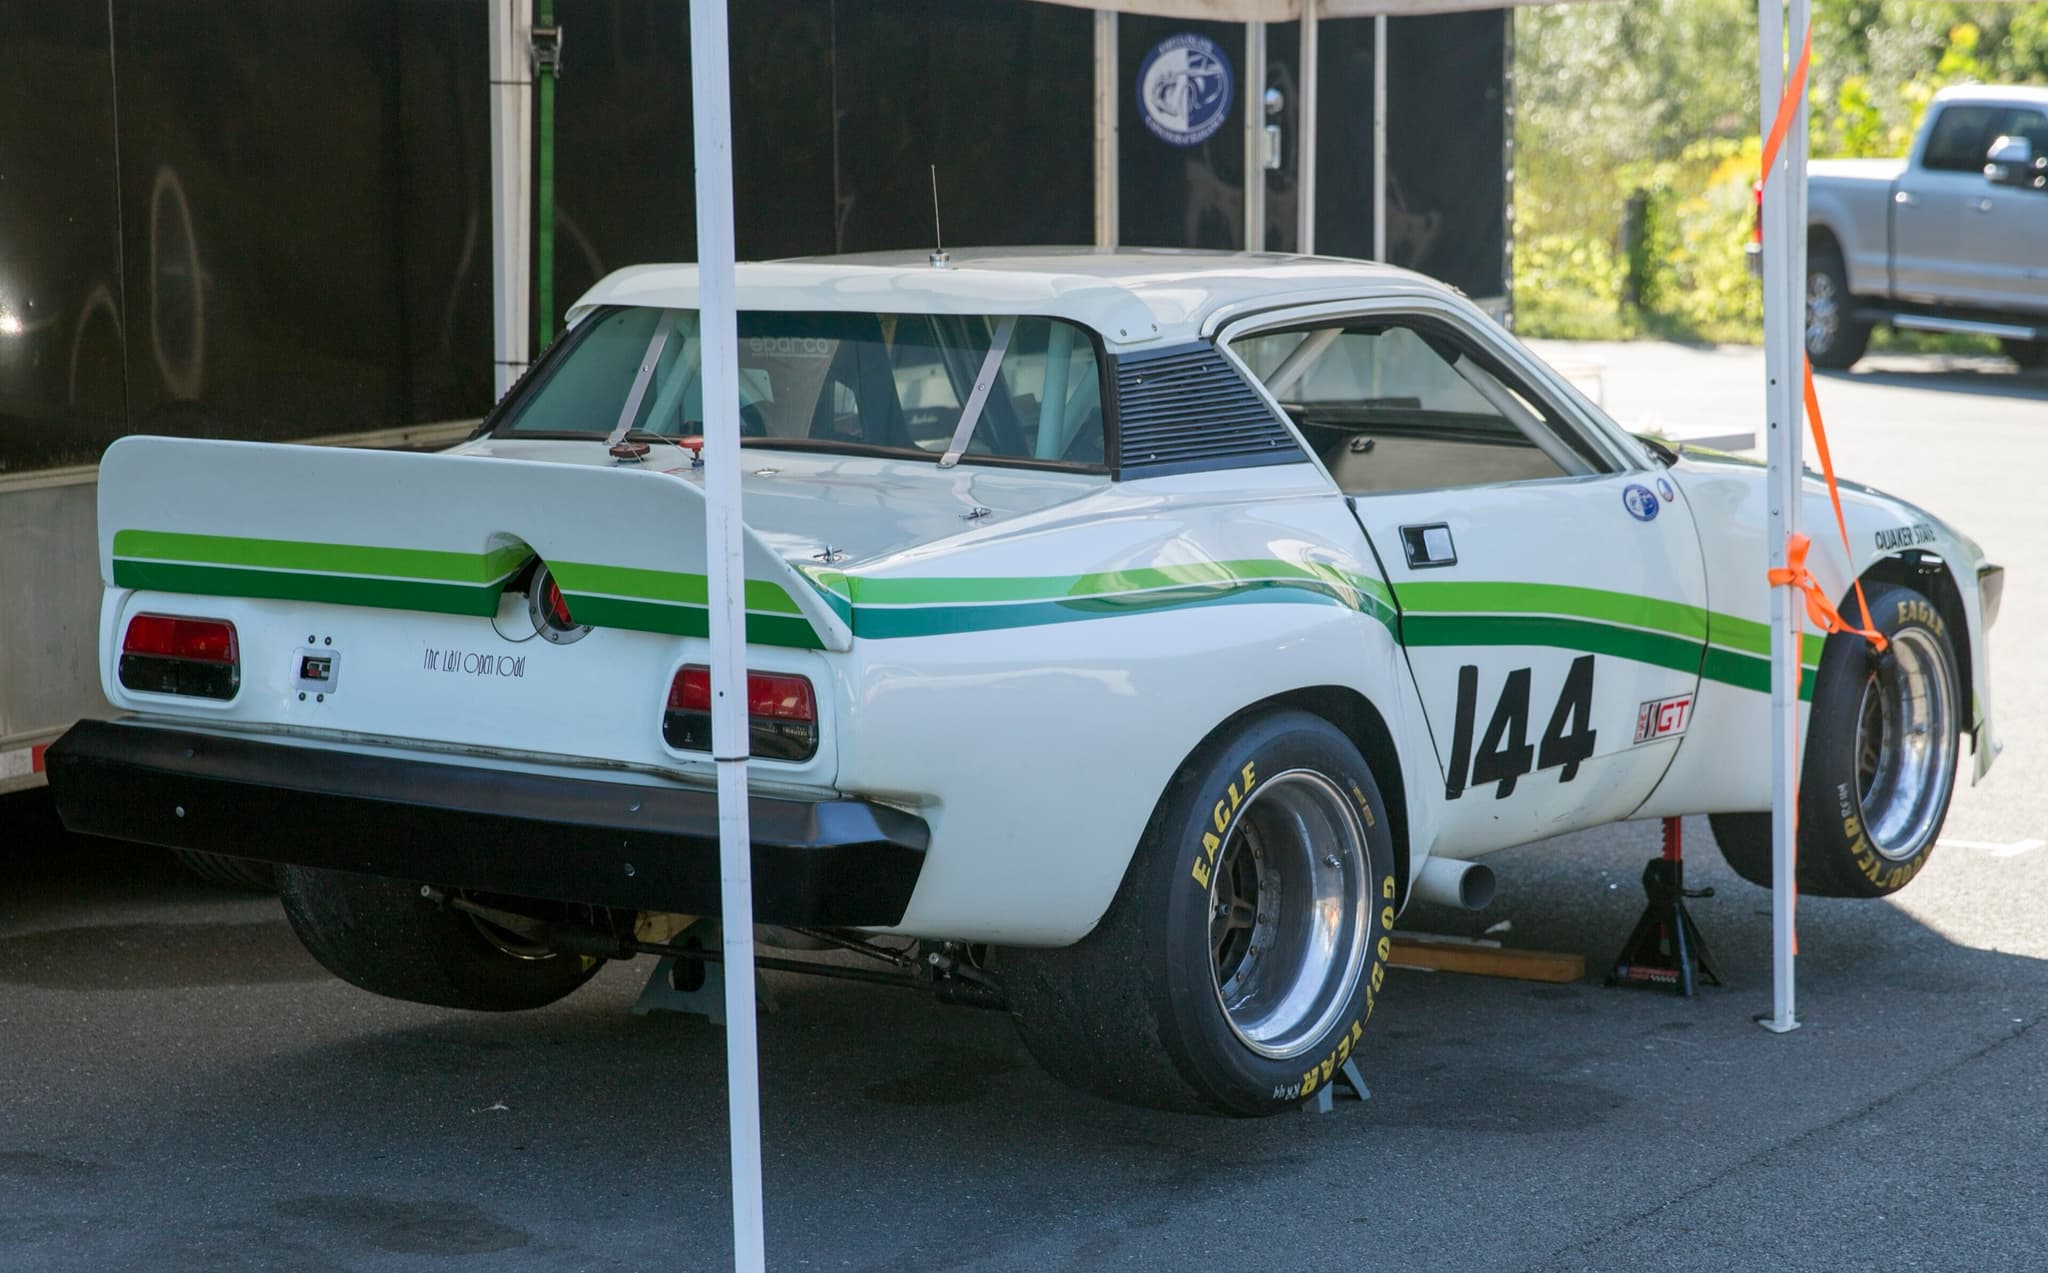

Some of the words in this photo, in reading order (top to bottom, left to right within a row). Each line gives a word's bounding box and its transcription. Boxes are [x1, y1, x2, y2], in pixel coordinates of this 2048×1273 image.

[750, 336, 829, 353] sparco
[1875, 526, 1913, 550] QUAKER
[1913, 523, 1936, 545] STATE
[1897, 600, 1944, 637] EAGLE
[1445, 654, 1597, 801] 144
[1657, 700, 1690, 732] GT
[1191, 760, 1256, 890] EAGLE
